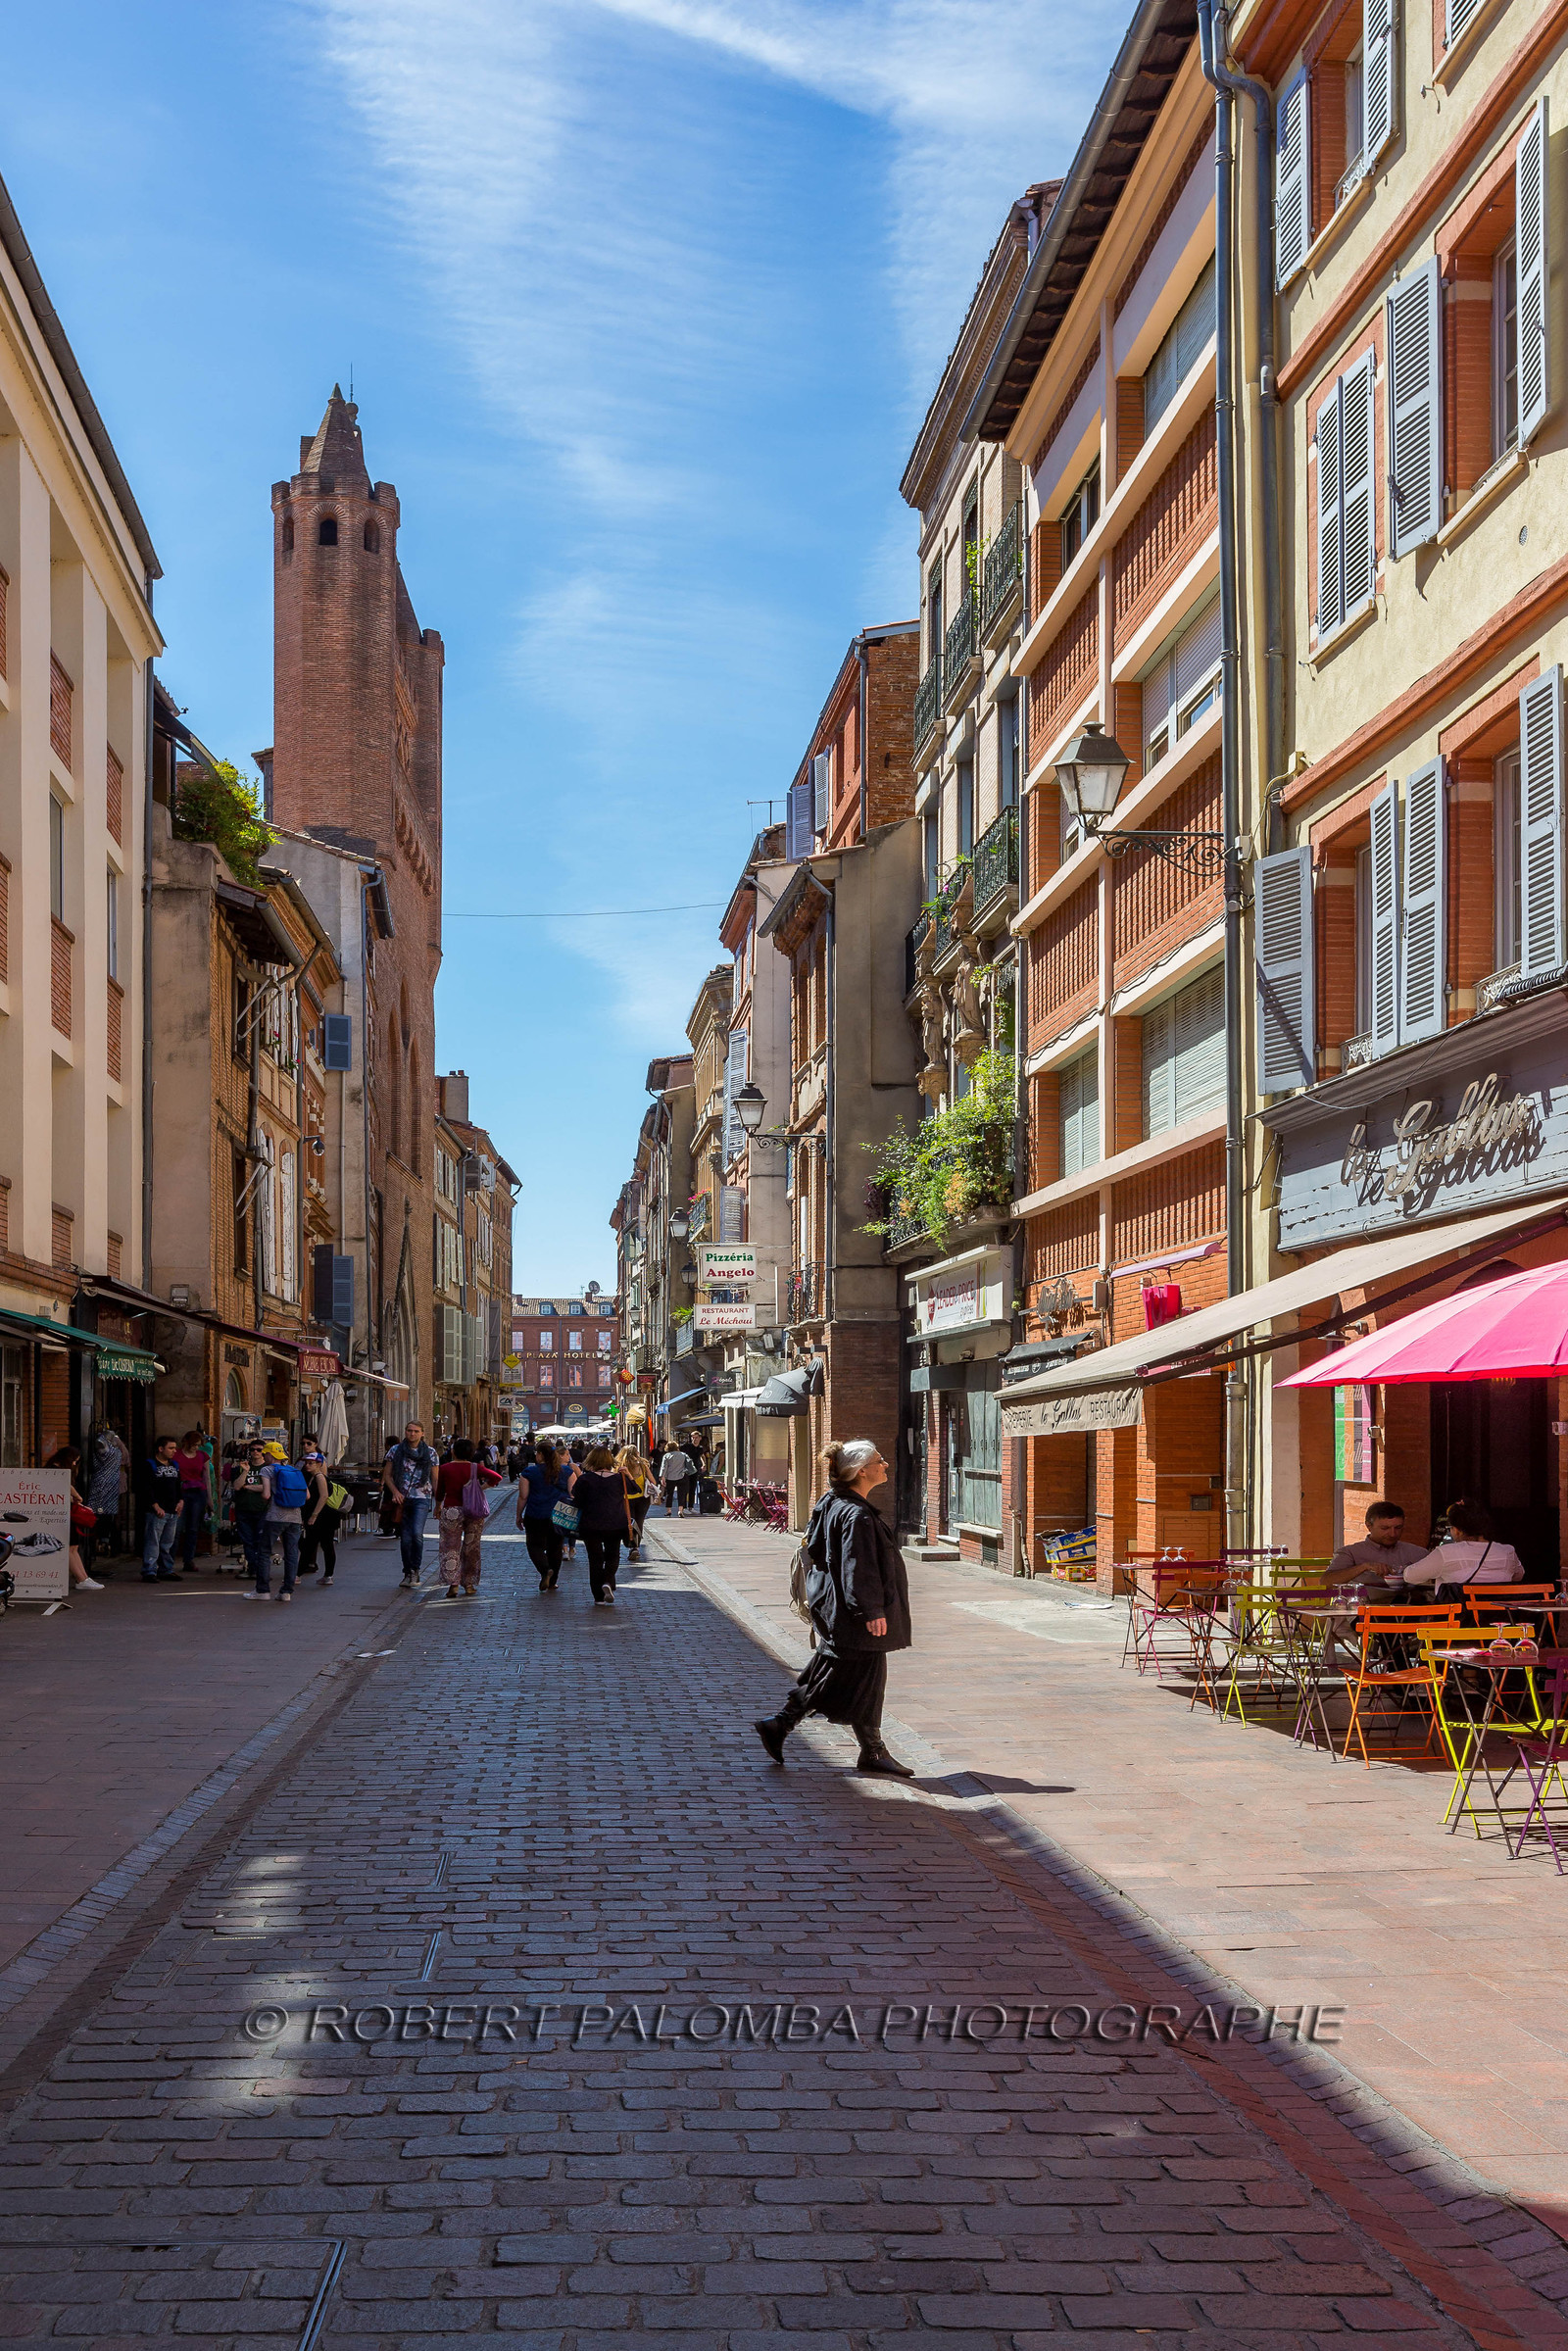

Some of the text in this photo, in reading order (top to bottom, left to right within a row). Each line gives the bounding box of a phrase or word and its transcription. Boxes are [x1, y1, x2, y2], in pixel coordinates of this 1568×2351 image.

[1384, 1072, 1530, 1197] Gallus
[706, 1252, 754, 1262] Pizzéria
[707, 1268, 755, 1279] Angelo
[957, 1279, 975, 1303] PRICE
[699, 1316, 753, 1325] Le Méchoui
[1090, 1395, 1137, 1420] RESTAURA
[19, 1481, 41, 1491] Éric
[24, 1570, 33, 1579] 13
[35, 1570, 46, 1579] 69
